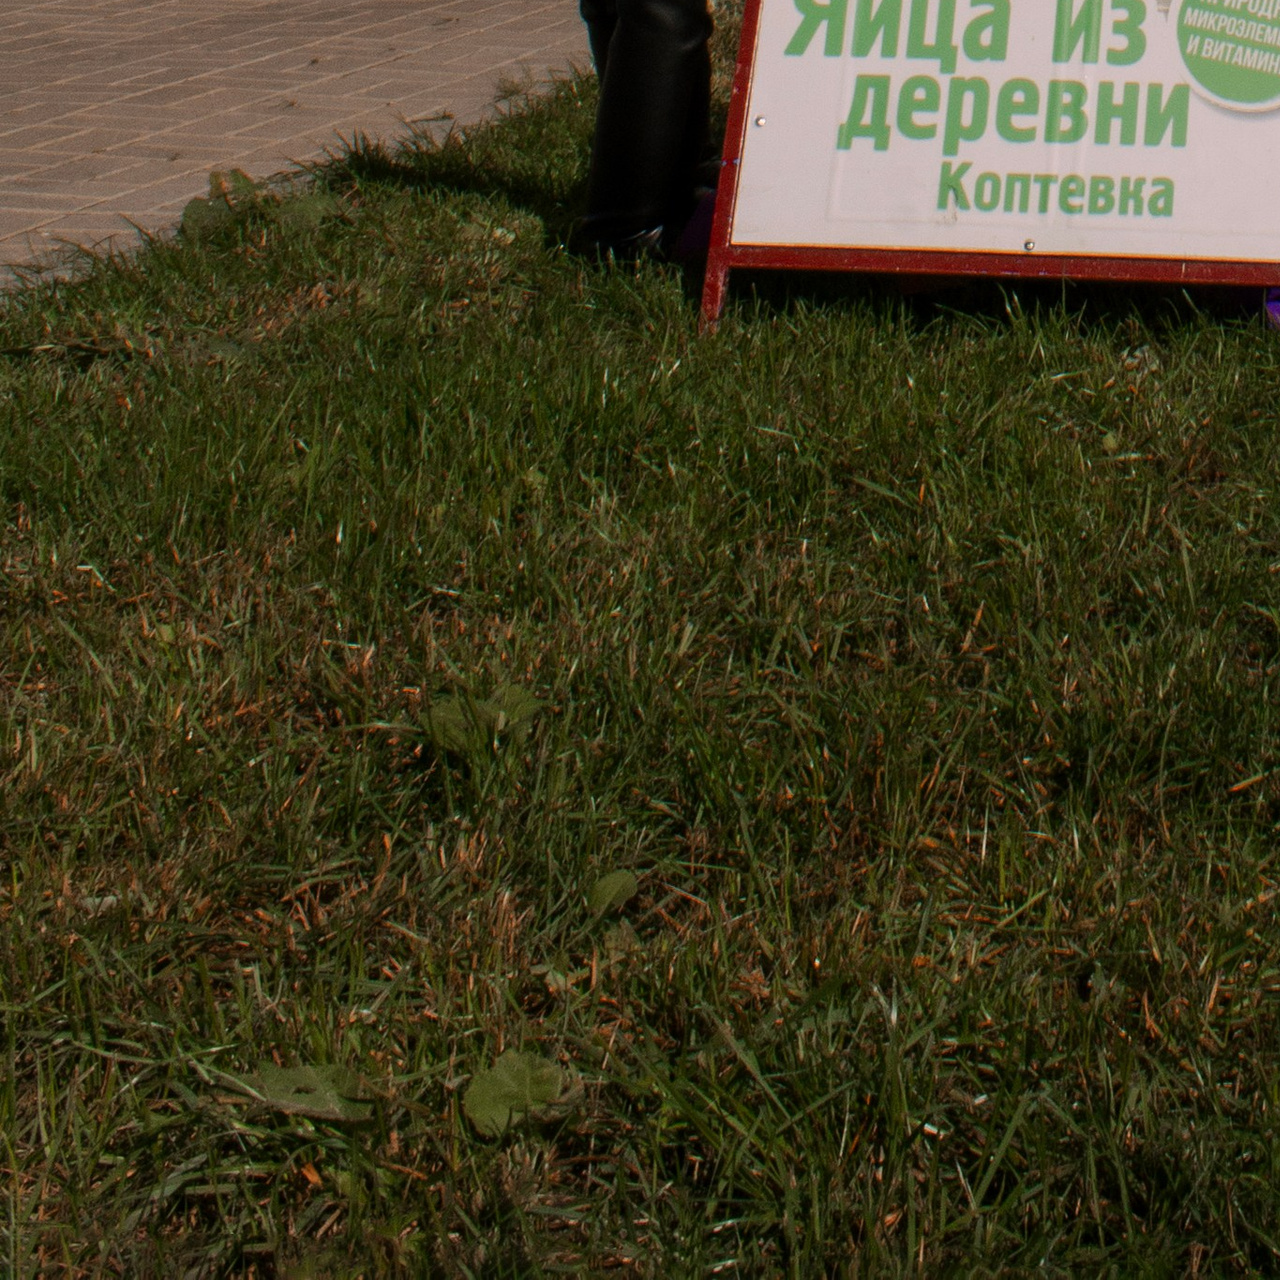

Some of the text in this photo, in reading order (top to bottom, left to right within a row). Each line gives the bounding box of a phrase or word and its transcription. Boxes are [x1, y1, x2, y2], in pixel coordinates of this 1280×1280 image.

[1186, 34, 1200, 55] И
[835, 73, 1190, 156] деревни
[936, 161, 1175, 218] Коптевка
